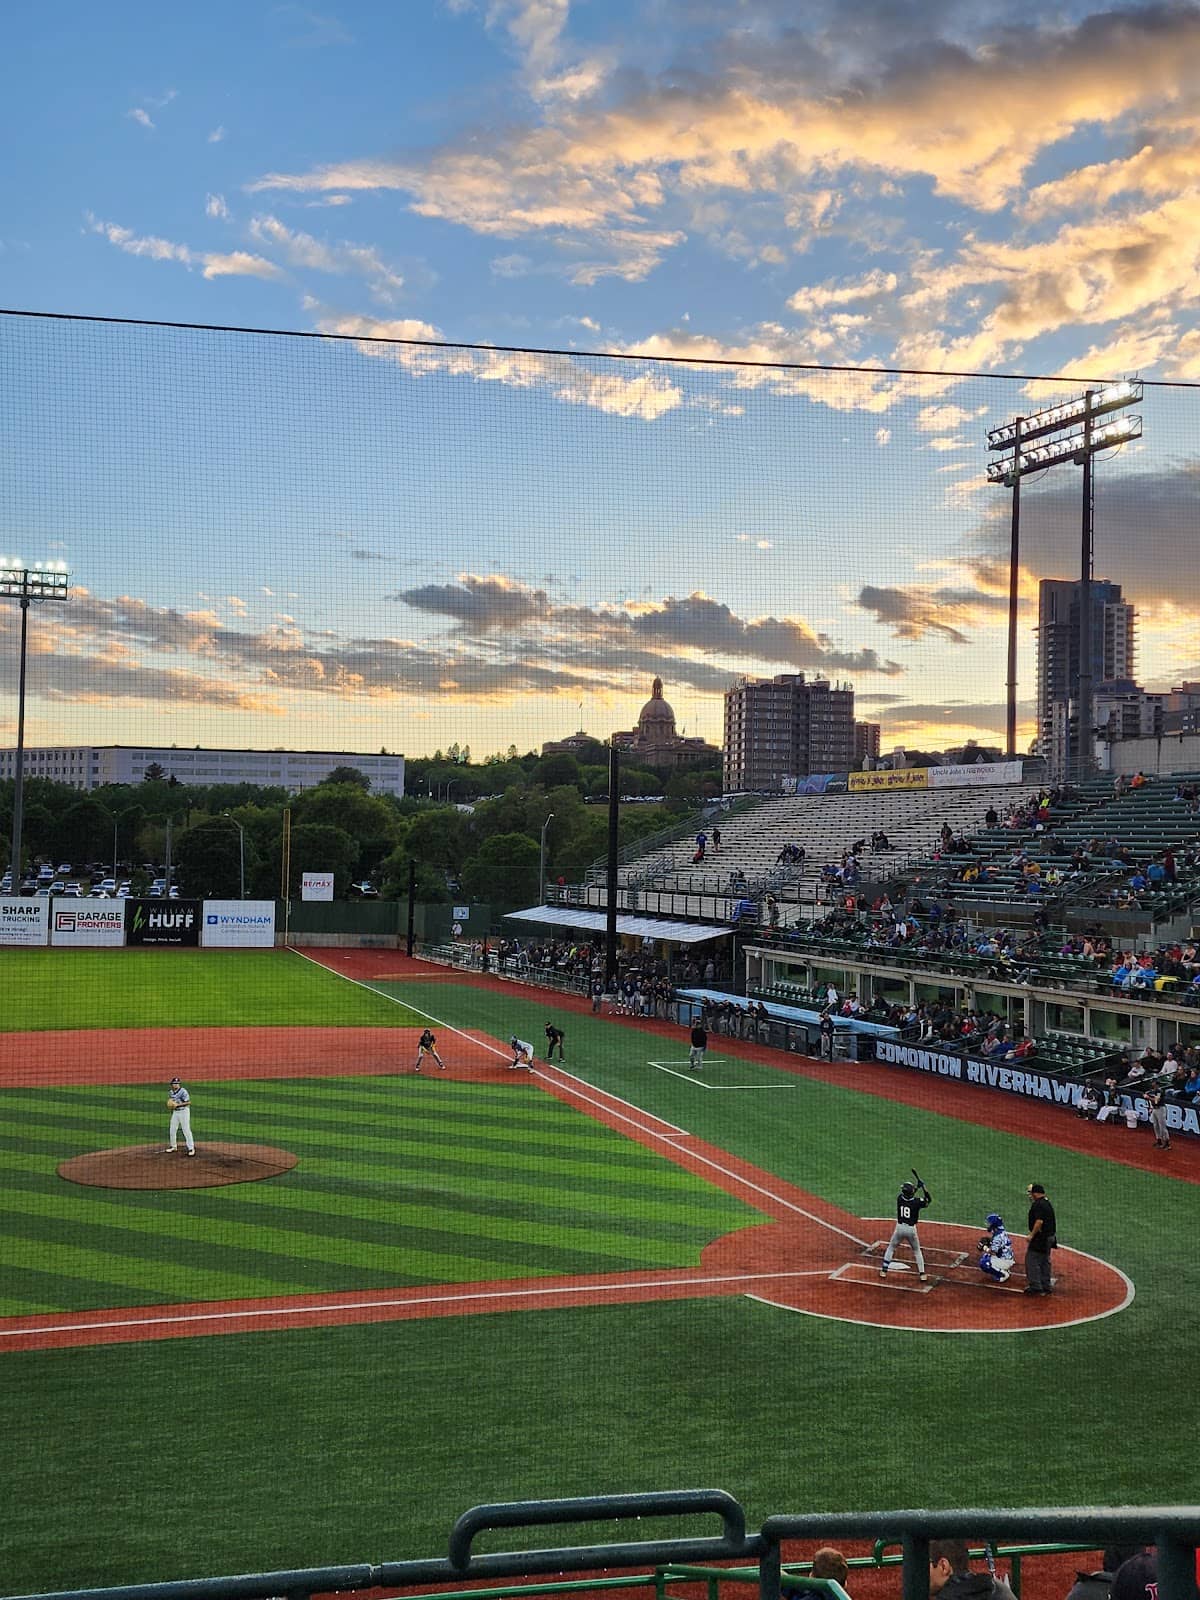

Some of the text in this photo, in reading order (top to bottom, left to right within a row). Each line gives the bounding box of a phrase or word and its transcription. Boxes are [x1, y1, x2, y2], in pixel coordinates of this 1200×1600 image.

[2, 906, 40, 915] SHARP
[77, 912, 121, 921] GARAGE
[148, 914, 194, 928] HUFF
[220, 915, 271, 924] WYNDHAM
[77, 921, 122, 929] FRONTIERS
[875, 1041, 962, 1078] EDMONTON
[967, 1061, 1086, 1106] RIVERHAWK
[900, 1206, 911, 1219] 18
